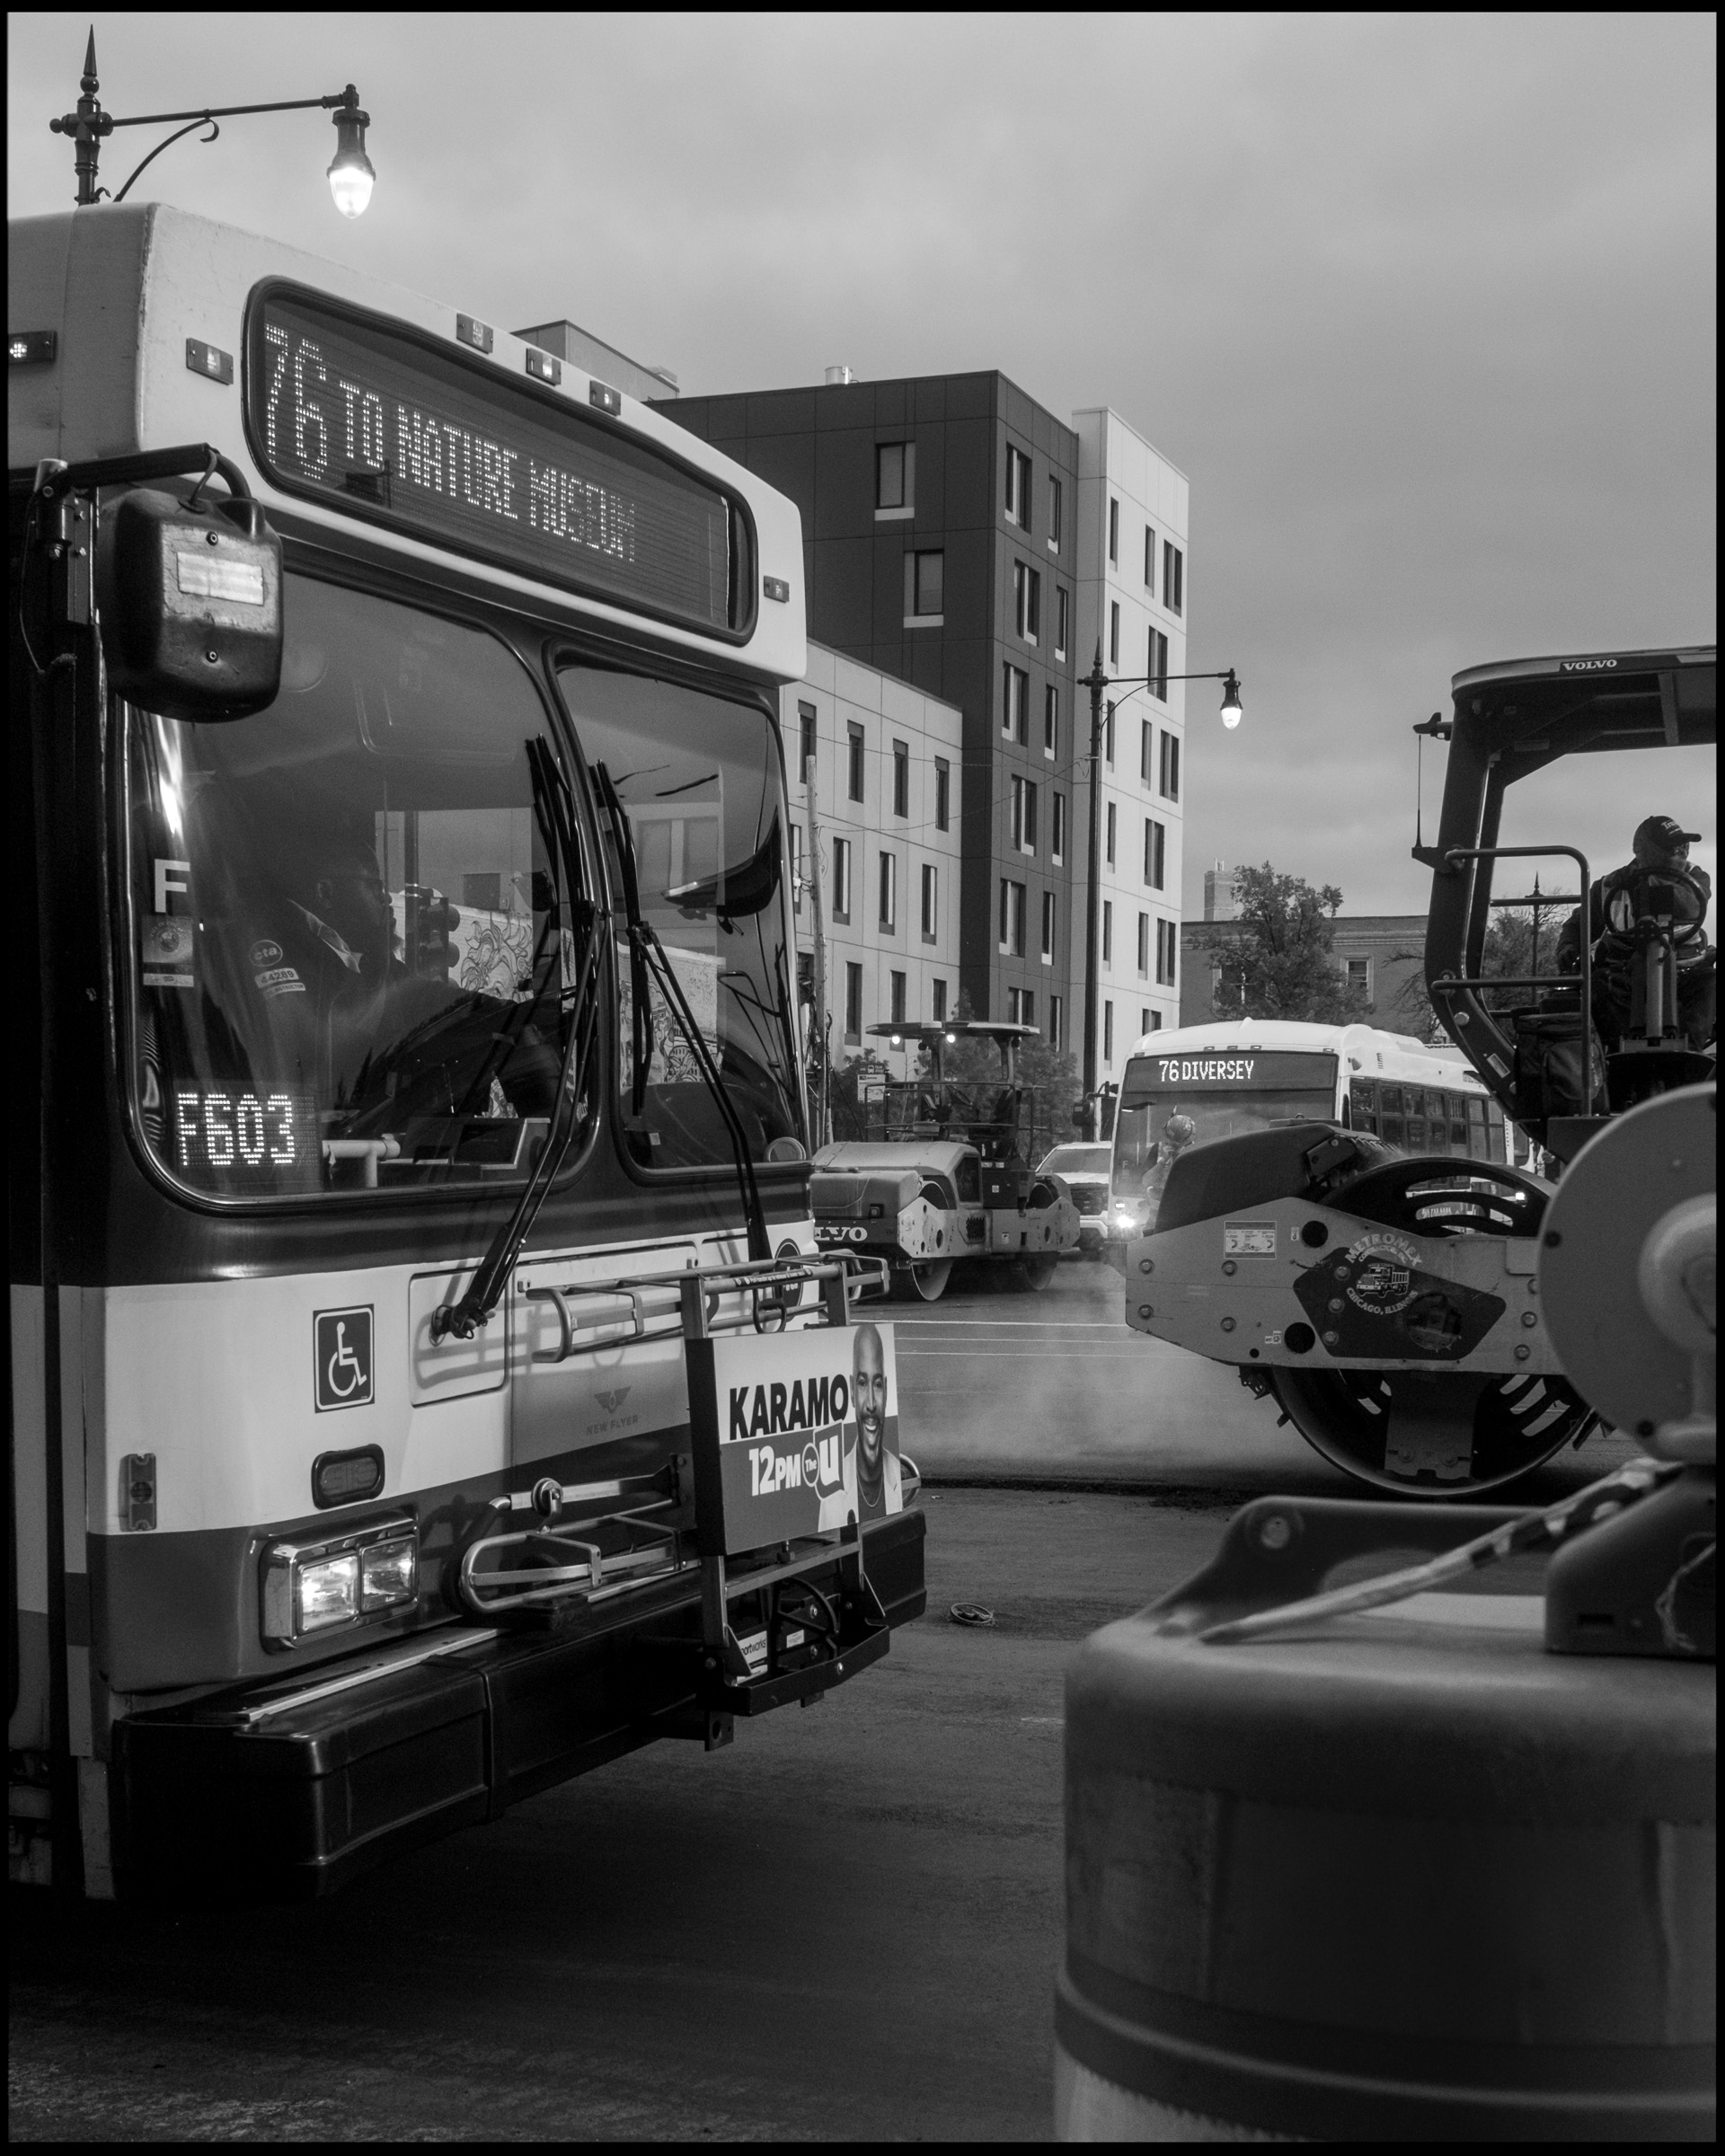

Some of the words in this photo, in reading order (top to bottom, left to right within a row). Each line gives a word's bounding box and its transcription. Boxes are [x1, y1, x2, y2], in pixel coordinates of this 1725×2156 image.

[266, 323, 328, 480] 76
[340, 380, 384, 469] TO
[398, 404, 518, 520] NATURE
[1562, 658, 1617, 671] VOLVO
[155, 858, 190, 914] F
[254, 946, 278, 960] cta
[261, 970, 295, 985] 44289
[1159, 1060, 1180, 1082] 76
[1181, 1060, 1254, 1081] DIVERSEY
[178, 1093, 295, 1166] F603
[1345, 1233, 1423, 1267] METROMEX
[1346, 1287, 1384, 1315] CHICAGO,
[730, 1374, 849, 1441] KARAMO
[586, 1421, 608, 1436] NEW
[610, 1414, 639, 1430] FLYER
[748, 1445, 801, 1497] 12PM
[805, 1458, 818, 1472] The
